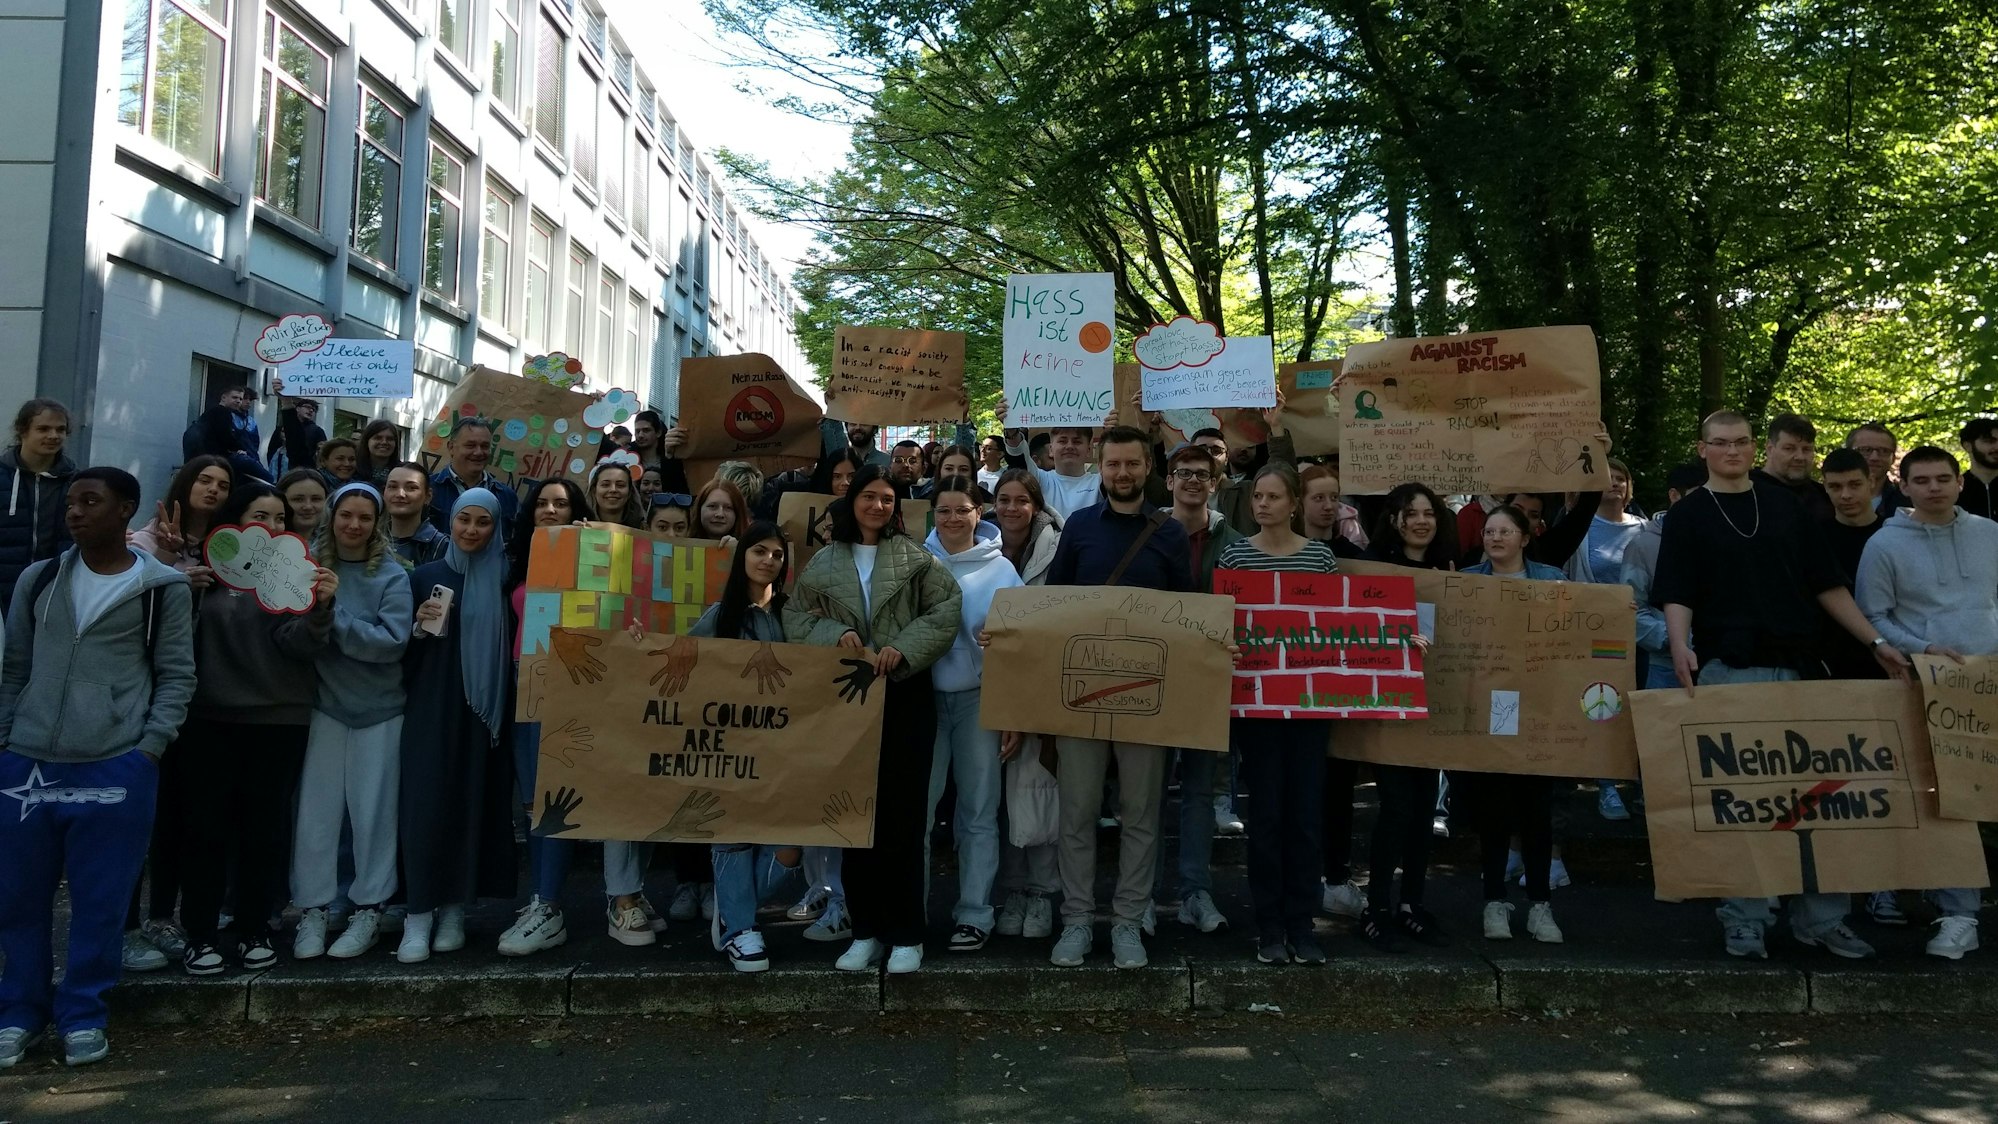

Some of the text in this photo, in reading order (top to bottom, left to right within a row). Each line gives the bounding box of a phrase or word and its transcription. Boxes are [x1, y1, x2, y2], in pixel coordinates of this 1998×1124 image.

[1011, 286, 1084, 319] Hass
[266, 328, 289, 342] Wir
[1038, 318, 1069, 342] ist
[337, 344, 385, 357] believe
[841, 336, 853, 352] In
[879, 347, 911, 358] racist
[918, 351, 949, 363] society
[1151, 335, 1198, 355] not hate
[1410, 337, 1498, 362] AGAINST
[305, 358, 399, 373] there is only
[878, 363, 904, 373] enough
[912, 367, 924, 375] to
[929, 368, 943, 378] be
[1457, 353, 1527, 374] RACISM
[288, 373, 313, 384] one
[752, 374, 764, 382] zu
[907, 381, 924, 390] must
[930, 383, 941, 391] be
[1145, 369, 1213, 388] Gemeinsam
[1217, 369, 1251, 383] gegen
[300, 385, 340, 395] human
[1013, 387, 1112, 411] MEINUNG
[1146, 387, 1191, 403] Rassismus
[1194, 382, 1209, 393] für
[1213, 383, 1231, 393] eine
[1231, 386, 1274, 402] Zukunft
[1454, 397, 1487, 410] STOP
[736, 410, 774, 422] RACISM
[1020, 412, 1101, 424] #Mensch ist Mensch
[1345, 420, 1368, 428] when
[1374, 428, 1420, 436] BE QUIET?
[1447, 463, 1485, 473] human
[526, 527, 731, 605] MENSCHE
[1223, 580, 1388, 599] Wir sind die
[1500, 580, 1573, 602] Freiheit
[996, 591, 1228, 645] Rassismus Nein Danke!
[1436, 607, 1496, 637] Religion
[1527, 611, 1605, 633] LGBTQ
[1235, 624, 1417, 657] BRANDMAUER
[1080, 645, 1161, 674] Miteinander!
[1929, 664, 1969, 689] Main
[1299, 692, 1415, 709] DEMOKRATIE
[642, 700, 789, 730] ALL COLOURS
[682, 729, 725, 753] ARE
[1933, 736, 1961, 758] Hand
[1966, 746, 1974, 760] in
[648, 753, 760, 780] BEAUTIFUL
[1710, 787, 1891, 825] Rassismus
